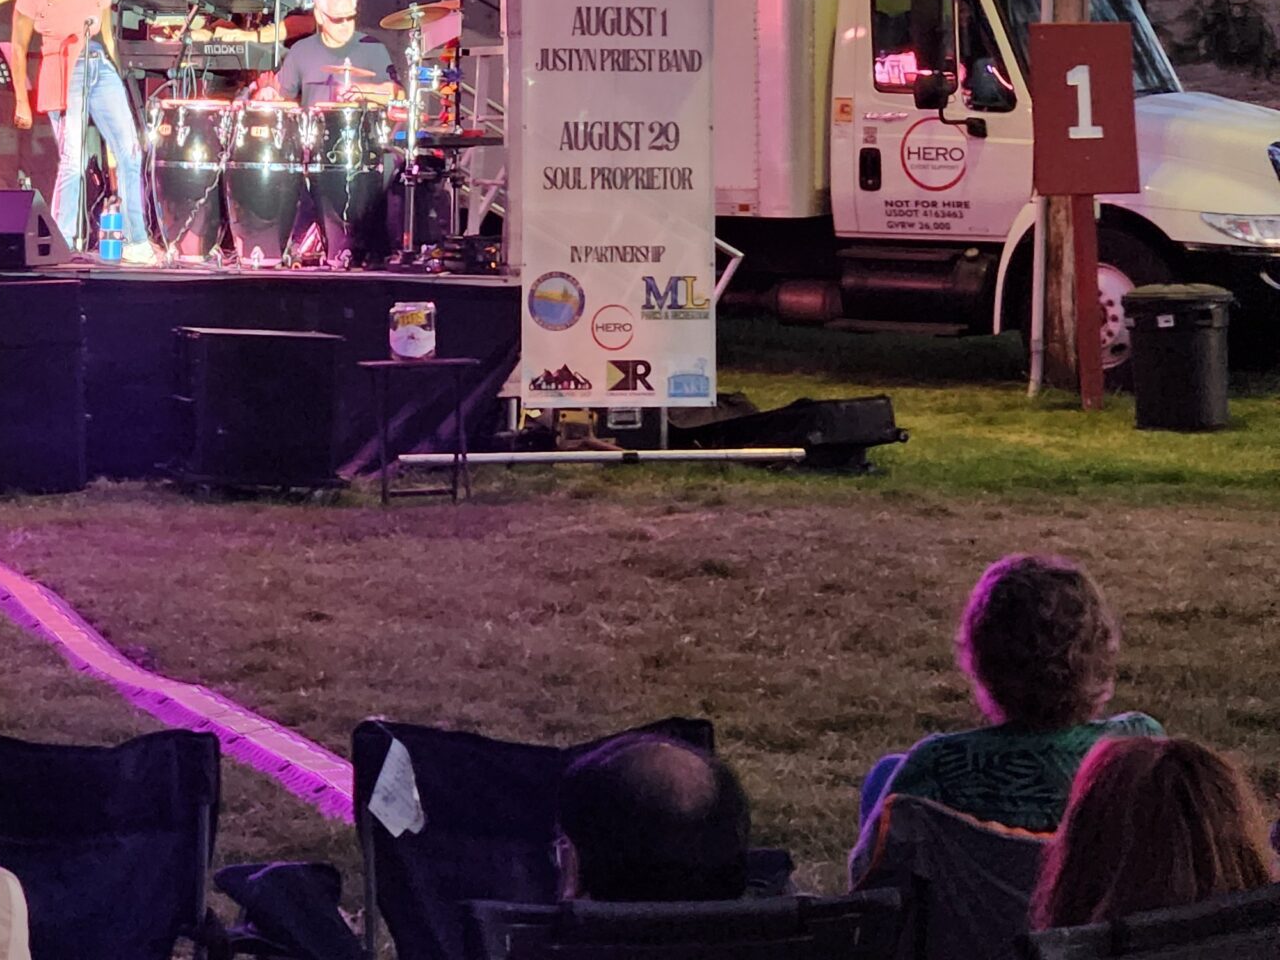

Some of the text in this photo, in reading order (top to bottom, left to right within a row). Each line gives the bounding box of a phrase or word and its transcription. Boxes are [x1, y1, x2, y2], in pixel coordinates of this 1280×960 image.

[571, 6, 669, 38] AUGUST 1
[535, 47, 703, 73] JUSTYN PRIEST BAND
[1065, 64, 1104, 139] 1
[559, 121, 681, 152] AUGUST 29
[907, 146, 965, 161] HERO
[542, 166, 694, 191] SOUL PROPRIETOR
[884, 200, 970, 210] NOT FOR HIRE
[885, 208, 919, 218] USDOT
[570, 245, 666, 263] IN PARTNERSHIP
[641, 276, 711, 310] ML
[595, 322, 633, 333] HERO
